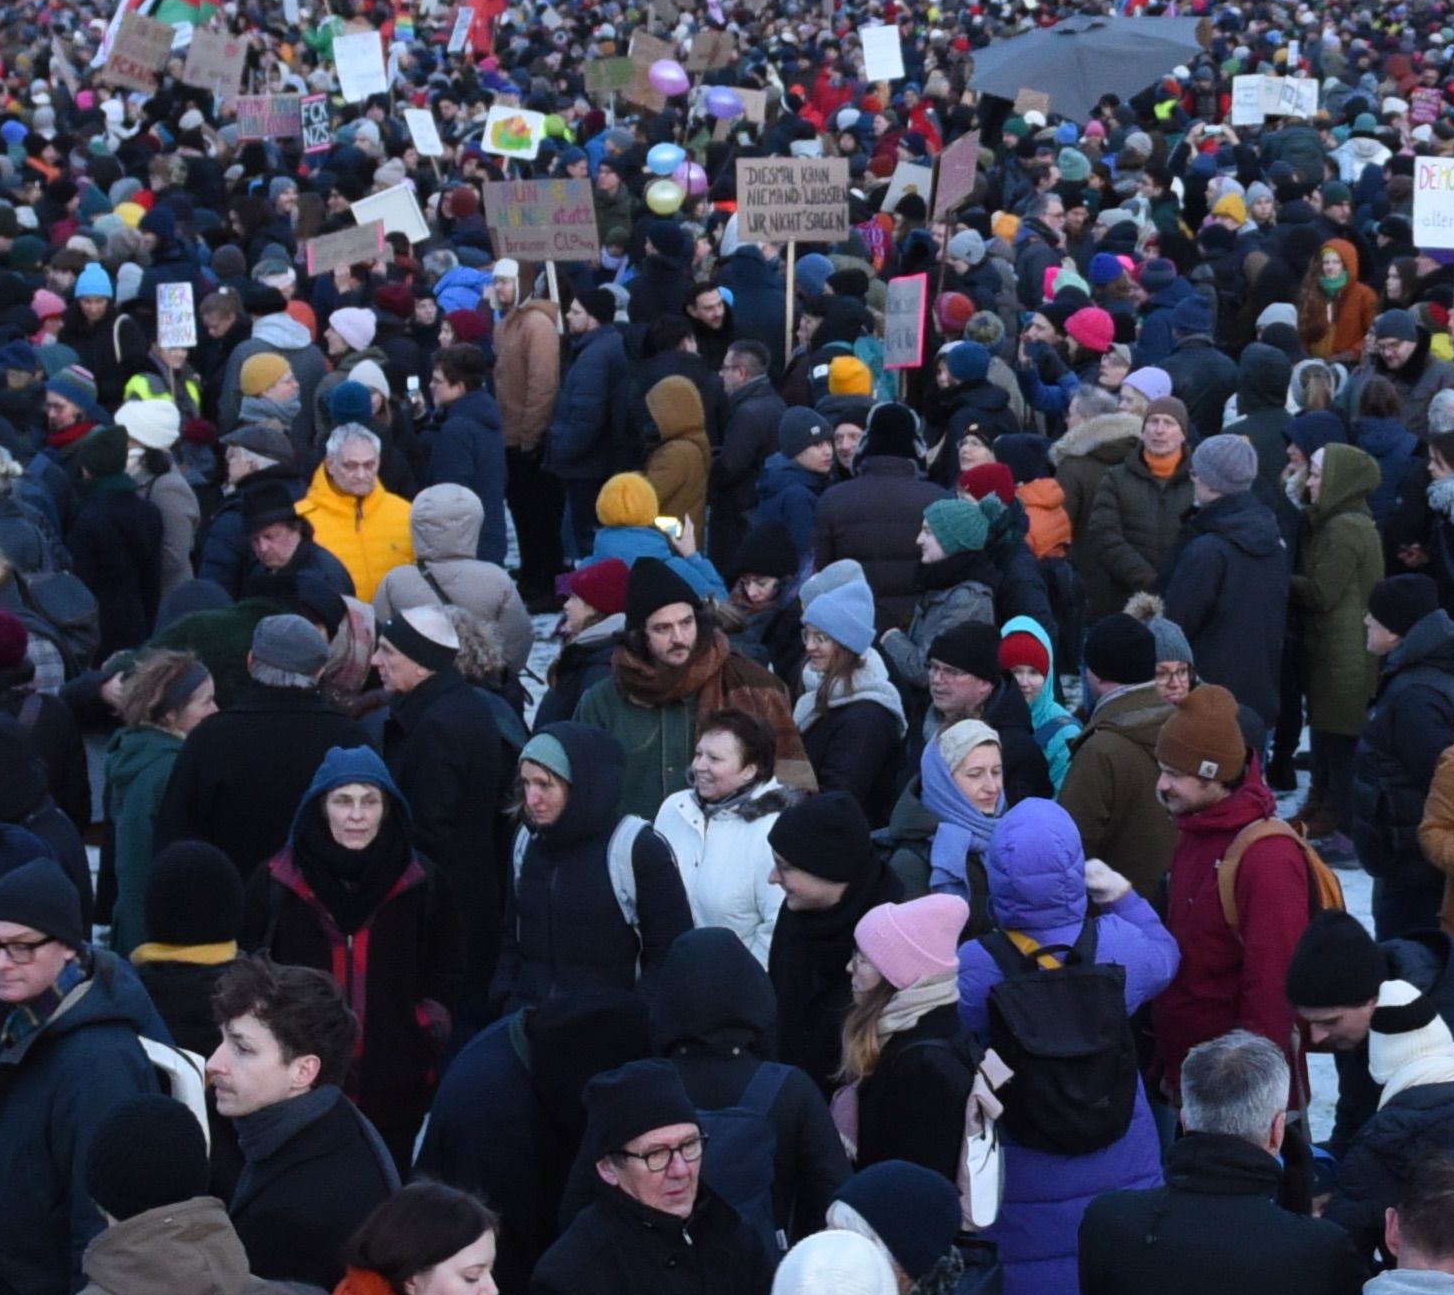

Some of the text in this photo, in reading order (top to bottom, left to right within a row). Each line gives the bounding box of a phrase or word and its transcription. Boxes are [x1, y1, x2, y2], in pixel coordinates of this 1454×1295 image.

[301, 101, 329, 125] FCK
[302, 122, 330, 148] NZS
[744, 165, 830, 185] DIESMAL KANN
[805, 207, 846, 232] SAGEN
